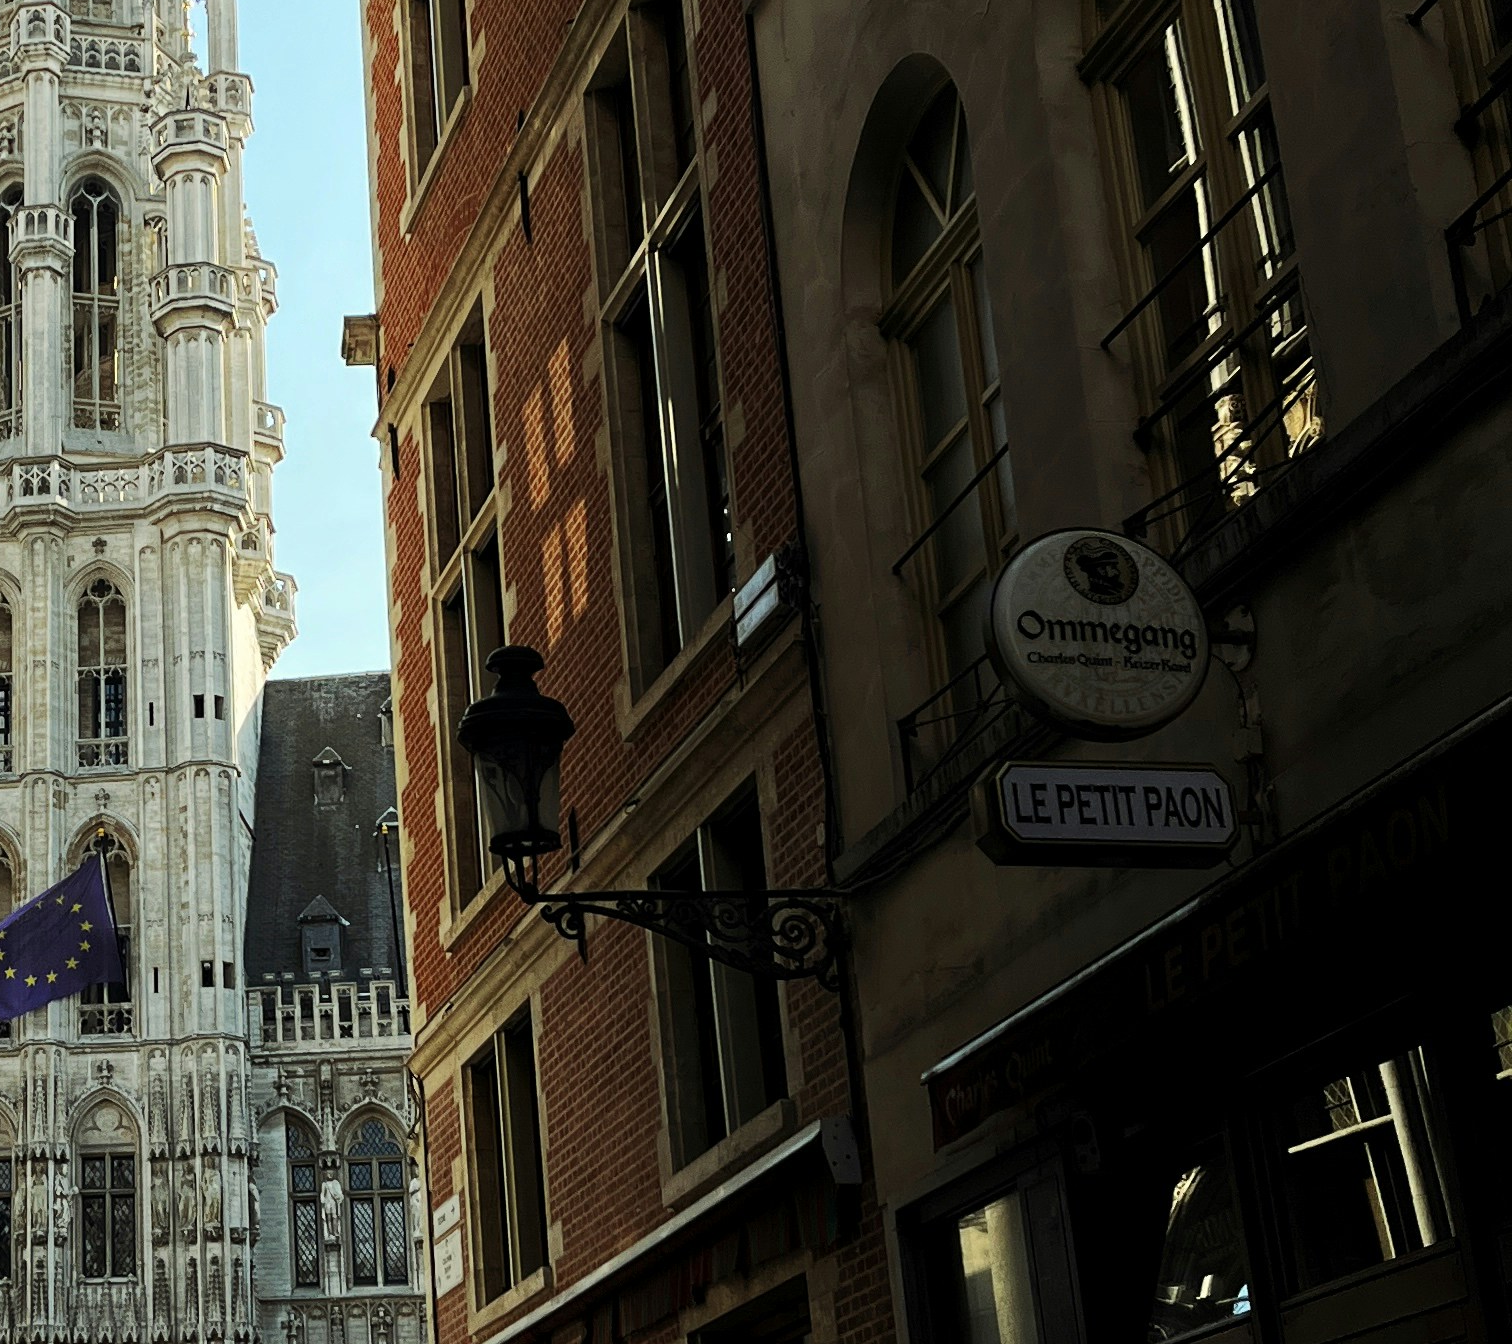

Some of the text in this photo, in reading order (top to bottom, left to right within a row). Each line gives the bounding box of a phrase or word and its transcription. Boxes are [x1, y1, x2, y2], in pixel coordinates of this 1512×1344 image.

[1017, 610, 1197, 660] Ommegang
[1027, 652, 1076, 665] Charles
[1077, 654, 1112, 668] Quint
[1011, 782, 1226, 829] LE PETIT PAON
